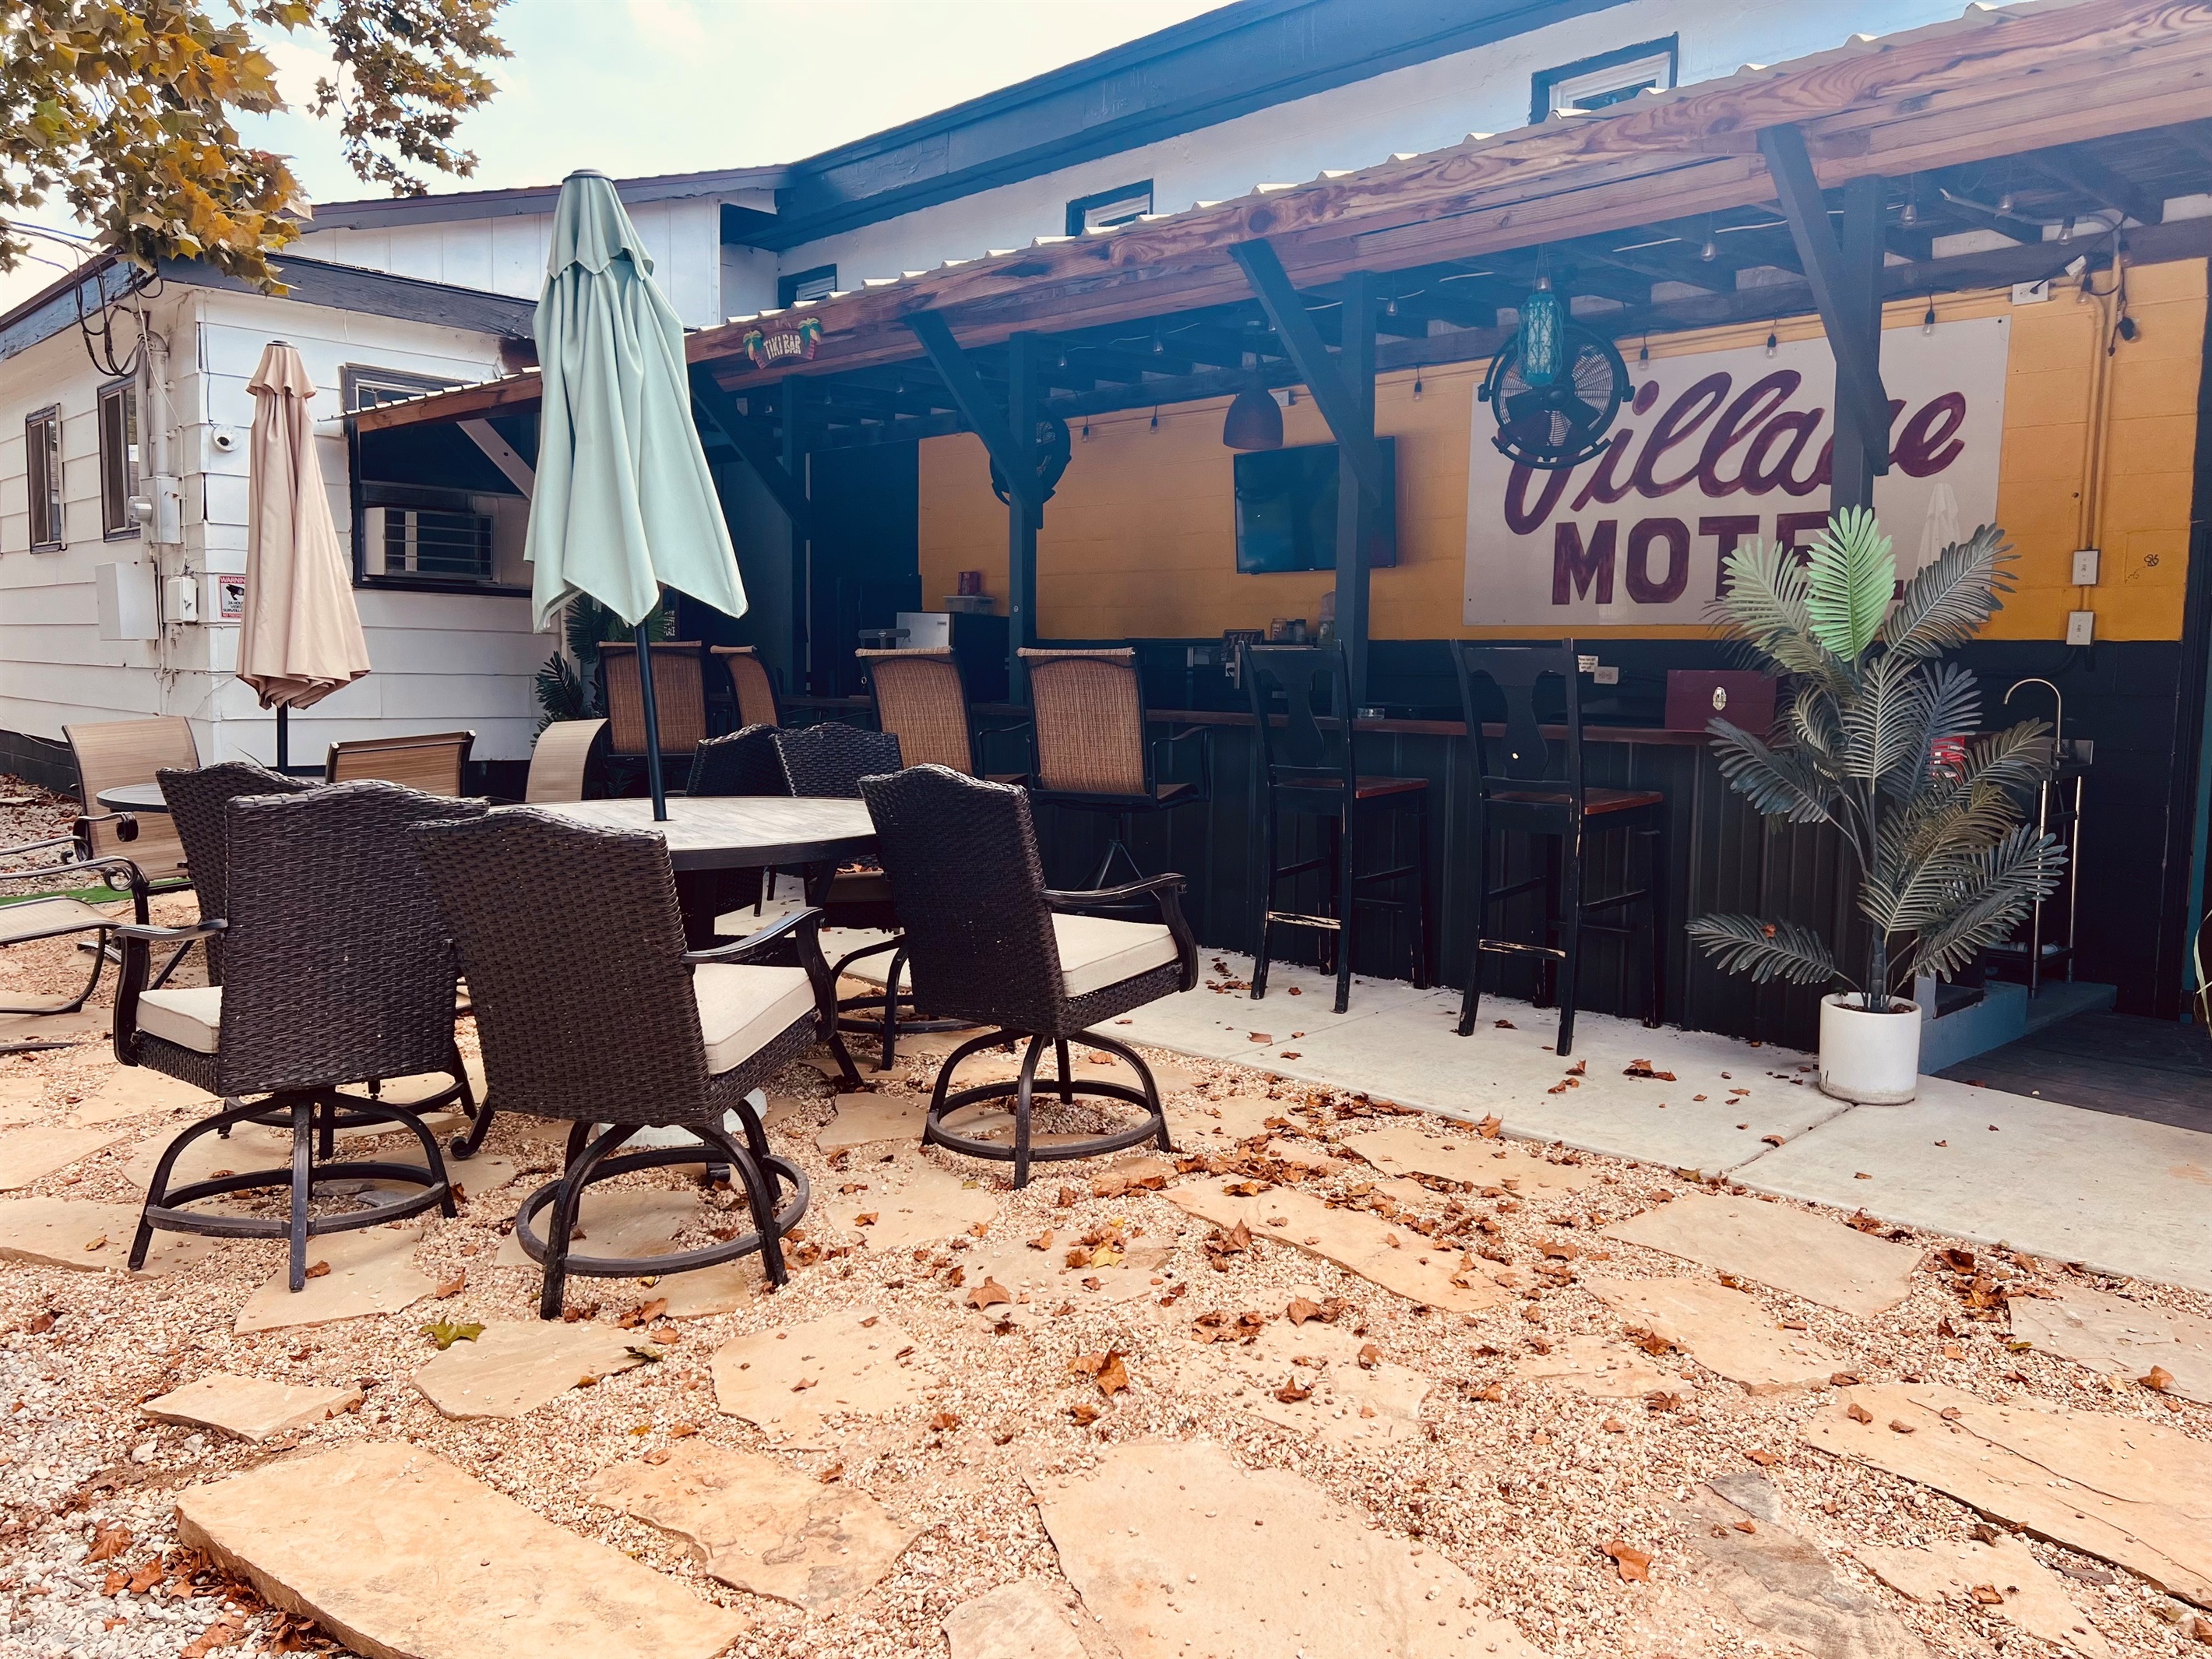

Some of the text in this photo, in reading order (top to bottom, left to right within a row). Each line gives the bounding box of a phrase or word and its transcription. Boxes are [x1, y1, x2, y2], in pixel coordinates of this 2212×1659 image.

[763, 334, 801, 360] TIKI BAR
[1498, 368, 1966, 535] Villae
[1552, 507, 1904, 605] MOTE
